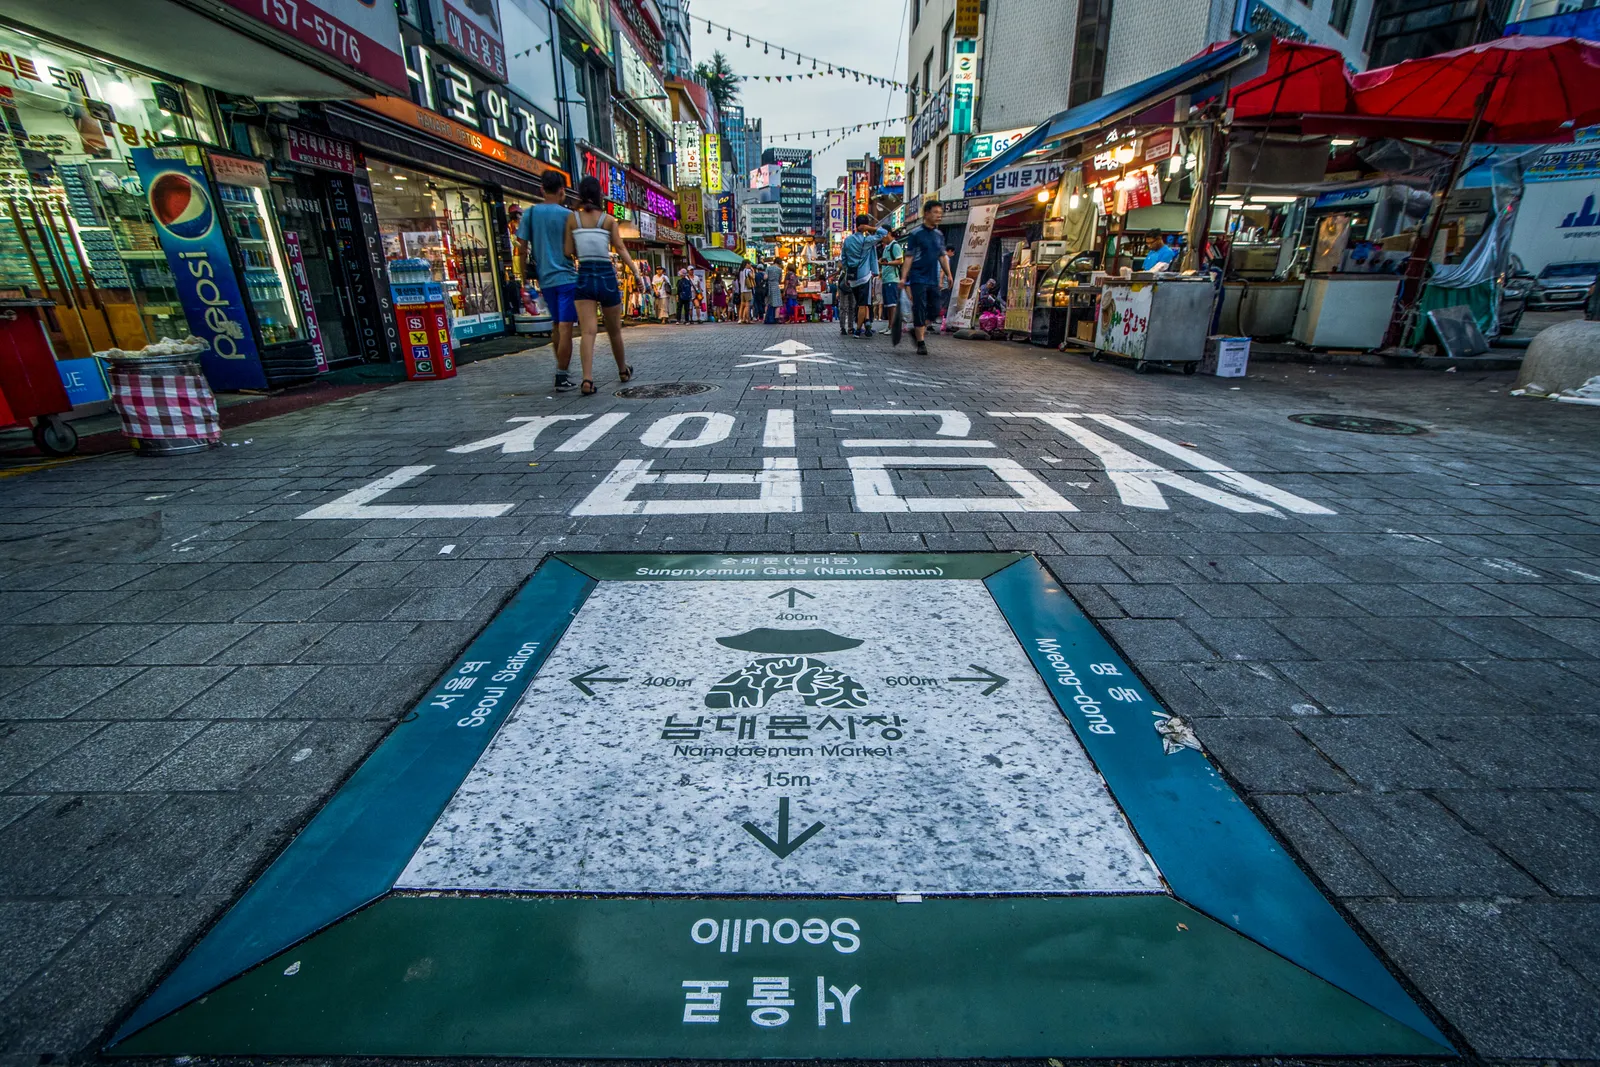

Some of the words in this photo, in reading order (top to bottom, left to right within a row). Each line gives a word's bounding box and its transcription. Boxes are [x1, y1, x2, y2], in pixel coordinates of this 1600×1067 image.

[456, 128, 483, 149] OPTICS
[996, 165, 1067, 190] 남대문지하
[363, 213, 373, 224] 2F
[684, 222, 702, 234] 안경
[969, 223, 991, 235] Organic
[287, 244, 299, 258] 2F
[968, 236, 986, 249] Coffee
[367, 237, 382, 279] PET
[179, 251, 246, 360] pepsi
[380, 298, 398, 353] SHOP
[415, 347, 429, 358] 元
[296, 406, 1337, 520] 진입금지
[635, 567, 756, 577] Sungnyemun
[763, 566, 807, 576] Gate
[813, 566, 945, 577] (Namdaemun)
[775, 613, 818, 621] 400m
[430, 661, 491, 709] 서울역
[457, 686, 508, 728] Seoul
[491, 641, 540, 682] Station
[641, 675, 694, 688] 400m
[885, 675, 939, 688] 600m
[1035, 638, 1116, 735] Myeong-dong
[1090, 662, 1143, 704] 명동
[660, 714, 909, 742] 남대문시장
[673, 744, 814, 757] Namdaemun
[820, 744, 893, 757] Market
[764, 771, 812, 788] 15m
[691, 917, 861, 954] Seoullo
[682, 976, 862, 1027] 서울로
